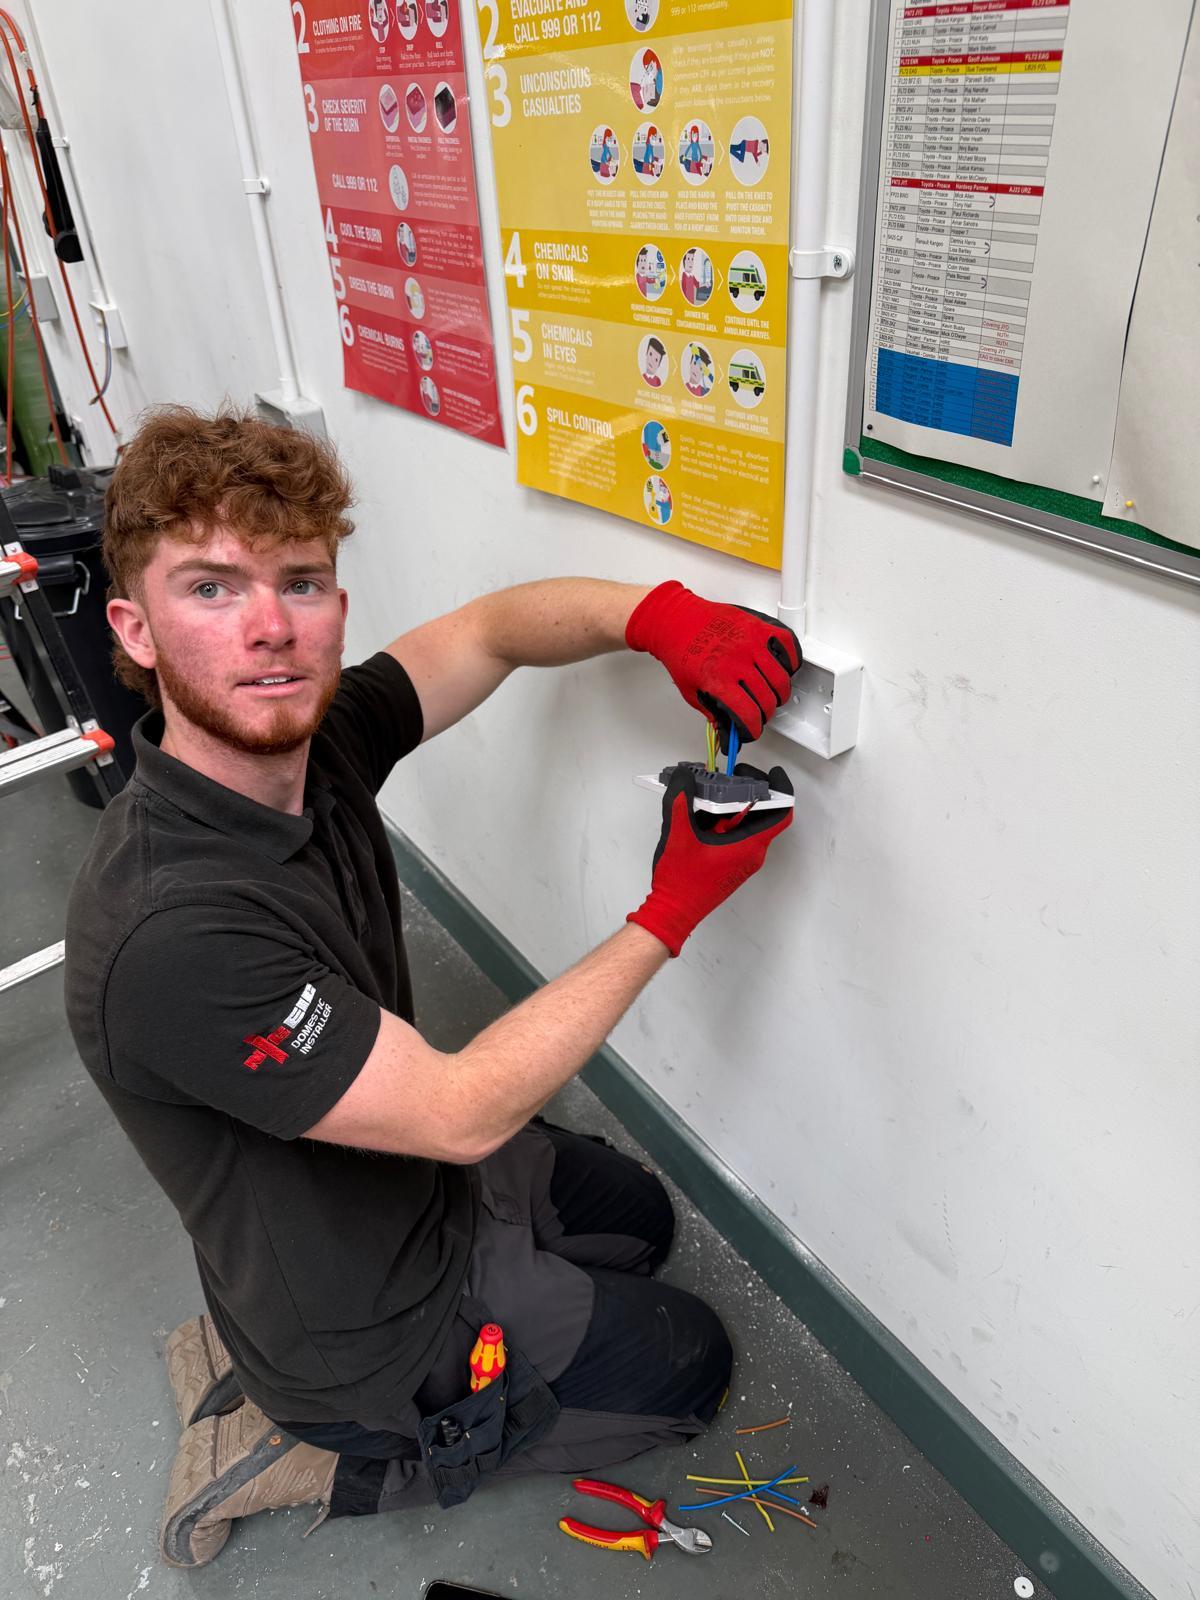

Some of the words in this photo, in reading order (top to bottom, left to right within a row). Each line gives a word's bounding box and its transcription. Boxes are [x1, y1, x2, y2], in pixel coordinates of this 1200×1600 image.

[292, 1, 310, 54] 2
[312, 18, 339, 36] CLOTHING
[340, 16, 348, 33] ON
[349, 14, 363, 32] FIRE
[479, 0, 506, 60] 2
[513, 21, 540, 43] CALL
[541, 17, 561, 39] 999
[563, 14, 579, 35] OR
[580, 10, 601, 33] 112
[488, 64, 511, 127] 3
[519, 66, 592, 95] UNCONSCIOUS
[304, 84, 319, 133] 3
[322, 100, 340, 115] CHECK
[341, 99, 367, 115] SEVERITY
[522, 93, 582, 118] CASUALTIES
[324, 117, 332, 132] OF
[332, 117, 343, 132] THE
[343, 118, 360, 132] BURN
[332, 174, 347, 189] CALL
[346, 175, 357, 190] 999
[356, 177, 366, 191] OR
[367, 178, 379, 193] 112
[325, 207, 339, 254] 4
[340, 222, 355, 238] COOL
[354, 225, 365, 240] THE
[365, 228, 383, 244] BURN
[505, 231, 528, 288] 4
[534, 241, 589, 264] CHEMICALS
[330, 256, 346, 300] 5
[348, 276, 368, 292] DRESS
[366, 280, 378, 296] THE
[377, 283, 395, 300] BURN
[536, 263, 550, 281] ON
[339, 304, 355, 347] 6
[357, 324, 385, 345] CHEMICAL
[383, 332, 405, 352] BURNS
[511, 308, 533, 364] 5
[541, 322, 593, 347] CHEMICALS
[543, 343, 554, 360] IN
[555, 344, 577, 364] EYES
[517, 385, 538, 436] 6
[546, 407, 572, 429] SPILL
[573, 413, 615, 440] CONTROL
[290, 997, 326, 1049] DOMESTIC
[299, 1003, 333, 1056] INSTALLER
